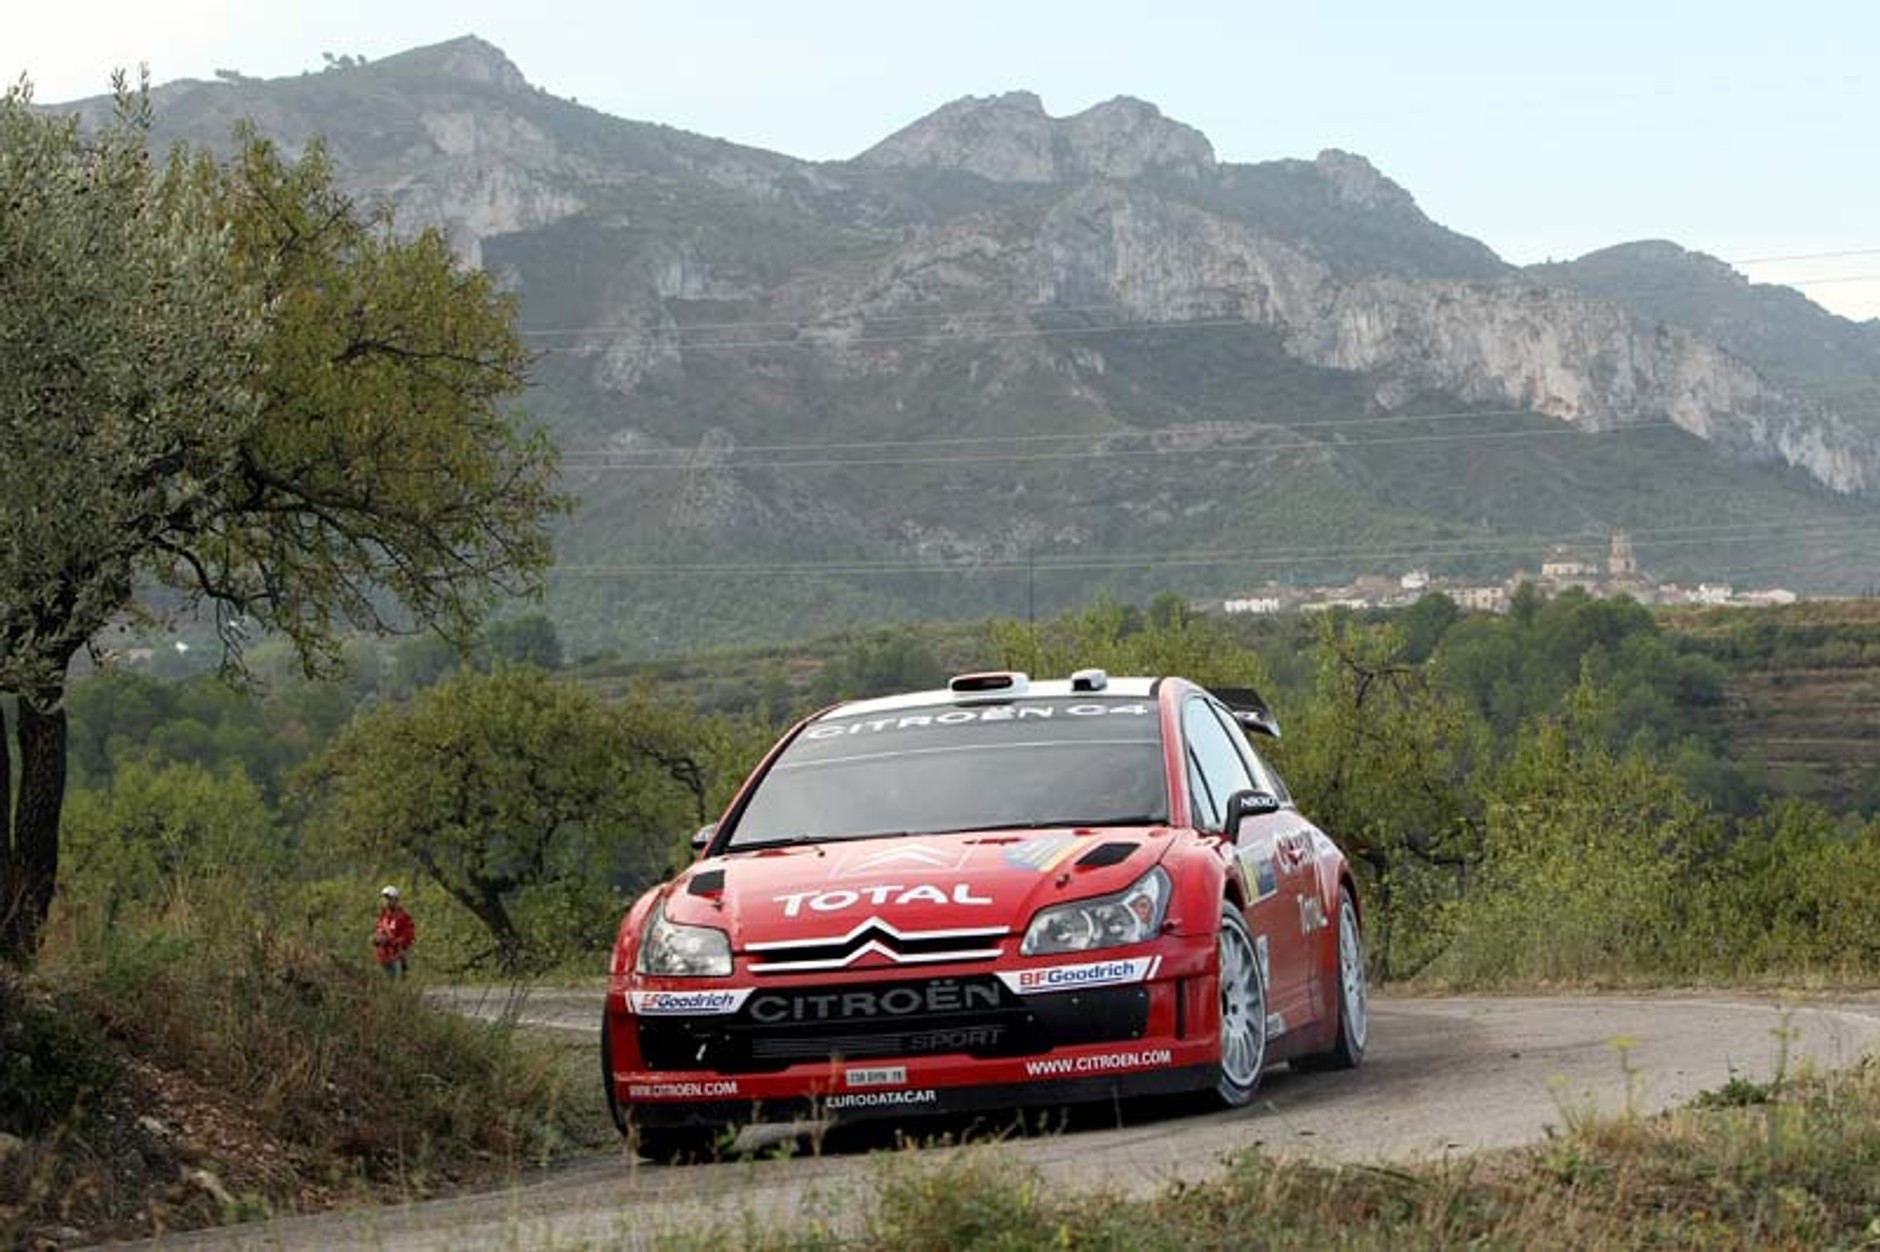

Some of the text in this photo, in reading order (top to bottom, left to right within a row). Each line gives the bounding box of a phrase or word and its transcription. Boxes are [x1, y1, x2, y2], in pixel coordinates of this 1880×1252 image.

[806, 702, 1148, 739] CITROËN C4
[773, 884, 993, 917] TOTAL
[1019, 962, 1135, 987] BFGoodrich
[750, 979, 1001, 1022] CITROËN
[1026, 1049, 1172, 1076] WWW.CITROEN.COM
